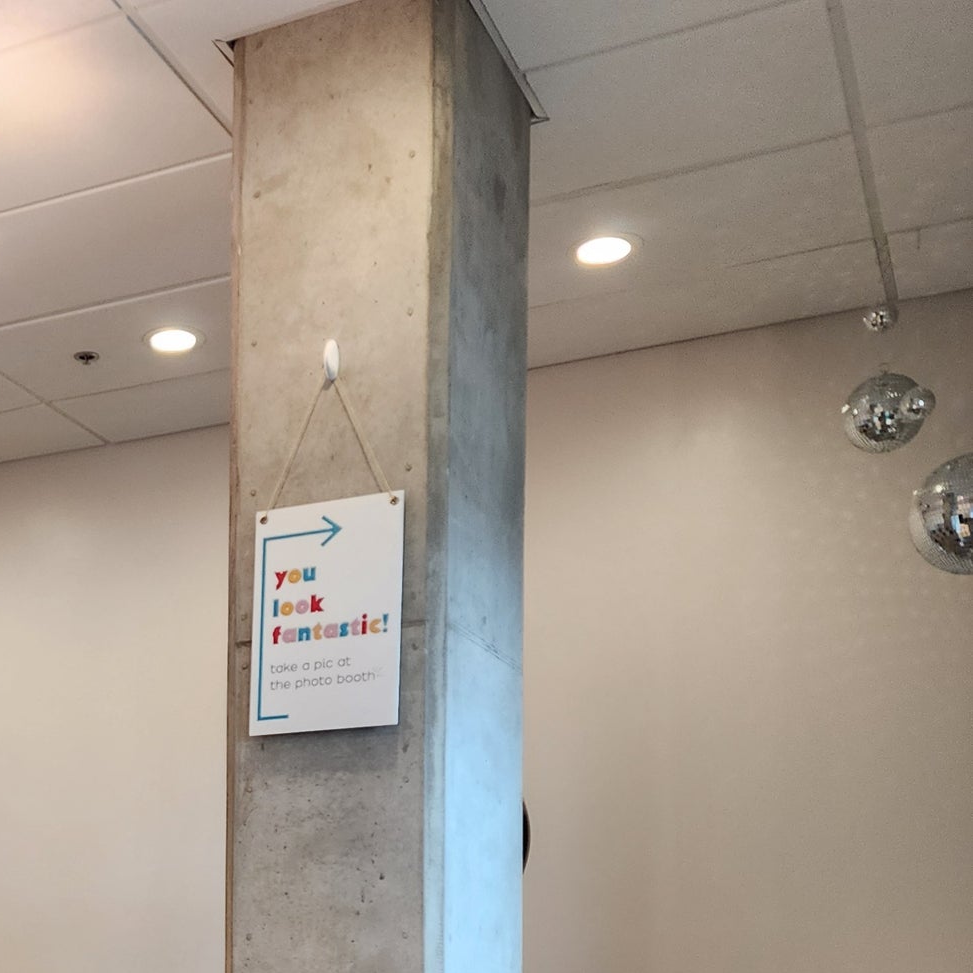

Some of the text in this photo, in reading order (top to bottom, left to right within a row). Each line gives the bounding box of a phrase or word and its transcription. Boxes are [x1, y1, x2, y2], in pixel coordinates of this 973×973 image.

[275, 567, 316, 590] you
[273, 595, 324, 617] look
[272, 614, 389, 644] fantastic!
[270, 657, 351, 674] take a pic at
[270, 671, 376, 690] the photo booth
